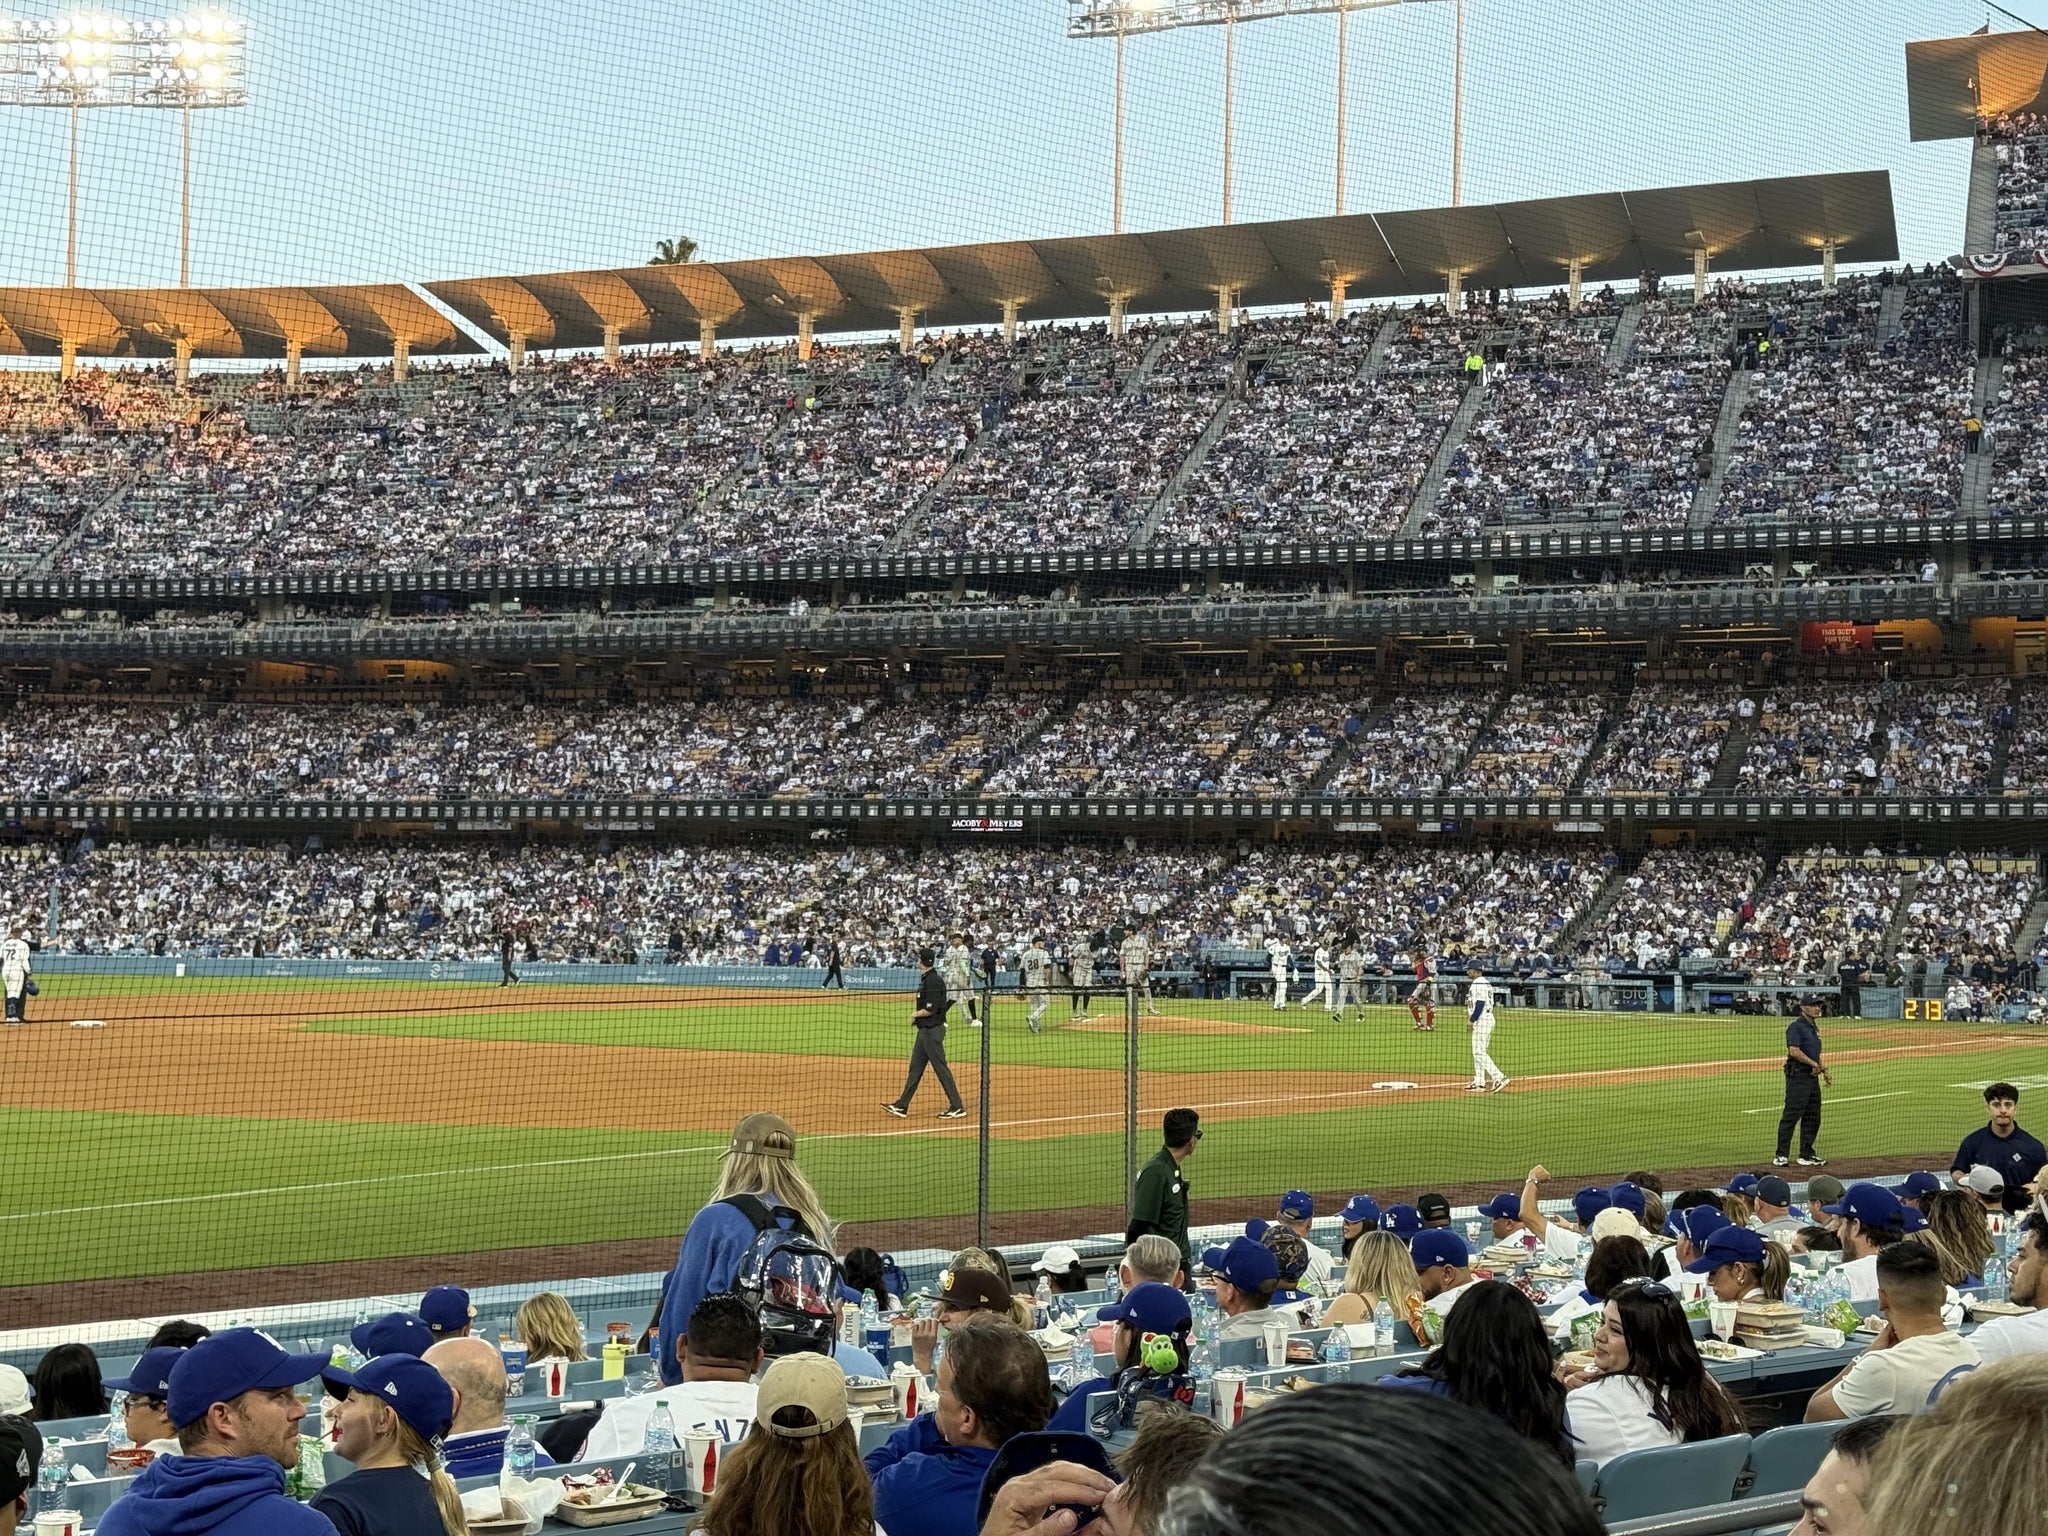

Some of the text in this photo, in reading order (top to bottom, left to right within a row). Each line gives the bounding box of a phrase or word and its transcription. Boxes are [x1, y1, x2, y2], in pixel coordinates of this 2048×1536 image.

[951, 819, 982, 828] JACOBY
[989, 819, 1023, 828] MEYERS
[5, 948, 16, 961] 72
[346, 965, 381, 975] Spectrum
[1027, 958, 1039, 971] 28
[1385, 1213, 1397, 1228] LA
